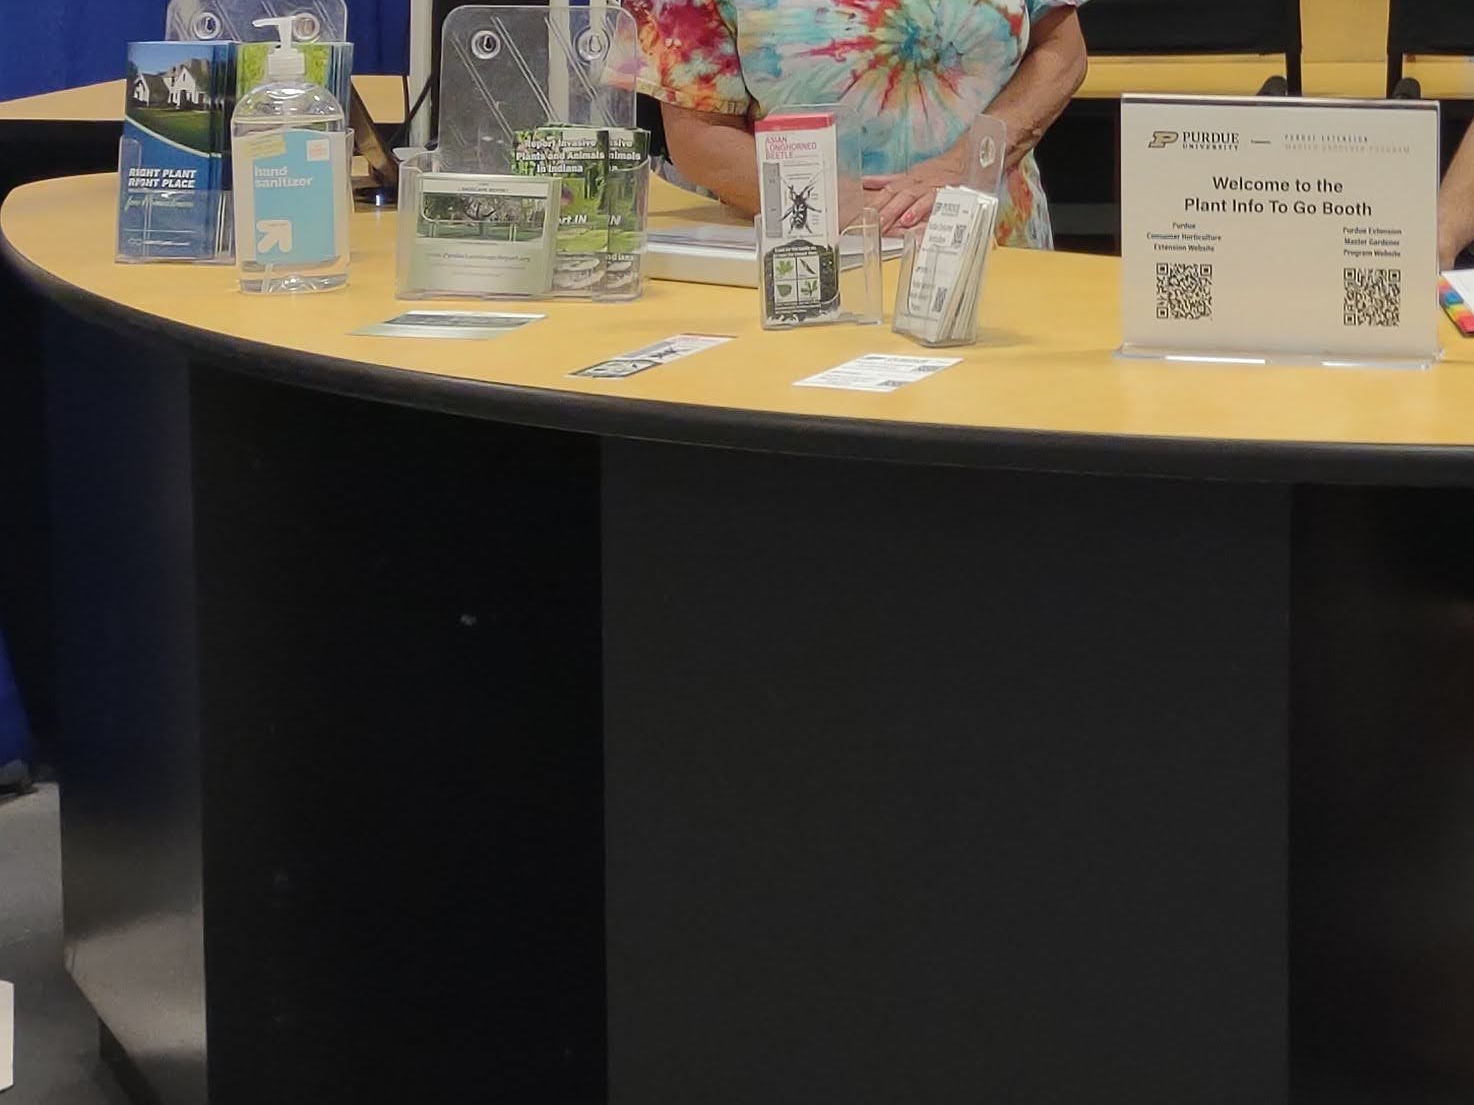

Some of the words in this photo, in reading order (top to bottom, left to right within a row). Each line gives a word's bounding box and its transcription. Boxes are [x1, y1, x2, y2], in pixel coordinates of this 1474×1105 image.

[765, 136, 788, 144] ASIAN
[1182, 131, 1239, 144] PURDUE
[765, 141, 817, 152] LONGHORNED
[516, 152, 547, 161] Plants
[547, 152, 565, 161] and
[567, 151, 605, 161] Animals
[765, 151, 794, 160] BEETLE
[128, 168, 160, 177] RIGHT
[162, 169, 197, 178] PLANT
[255, 165, 288, 176] hand
[548, 164, 584, 173] Indiana
[128, 178, 160, 188] RIGHT
[161, 179, 196, 188] PLACE
[254, 177, 313, 188] sanitizer
[1212, 176, 1289, 192] Welcome
[1295, 178, 1311, 193] to
[1316, 178, 1343, 193] the
[1184, 197, 1228, 213] Plant
[1232, 198, 1264, 214] Info
[1269, 200, 1288, 214] To
[1293, 201, 1317, 215] Go
[1322, 201, 1372, 216] Booth
[1172, 222, 1196, 230] Purdue
[1342, 226, 1366, 235] Purdue
[1368, 227, 1402, 235] Extension
[1146, 232, 1180, 241] Consumer
[1181, 232, 1222, 242] Horticulture
[1344, 237, 1368, 246] Master
[1369, 238, 1401, 247] Gardener
[1153, 243, 1187, 252] Extension
[1188, 244, 1215, 253] Website
[1343, 249, 1373, 258] Program
[1374, 250, 1401, 258] Website
